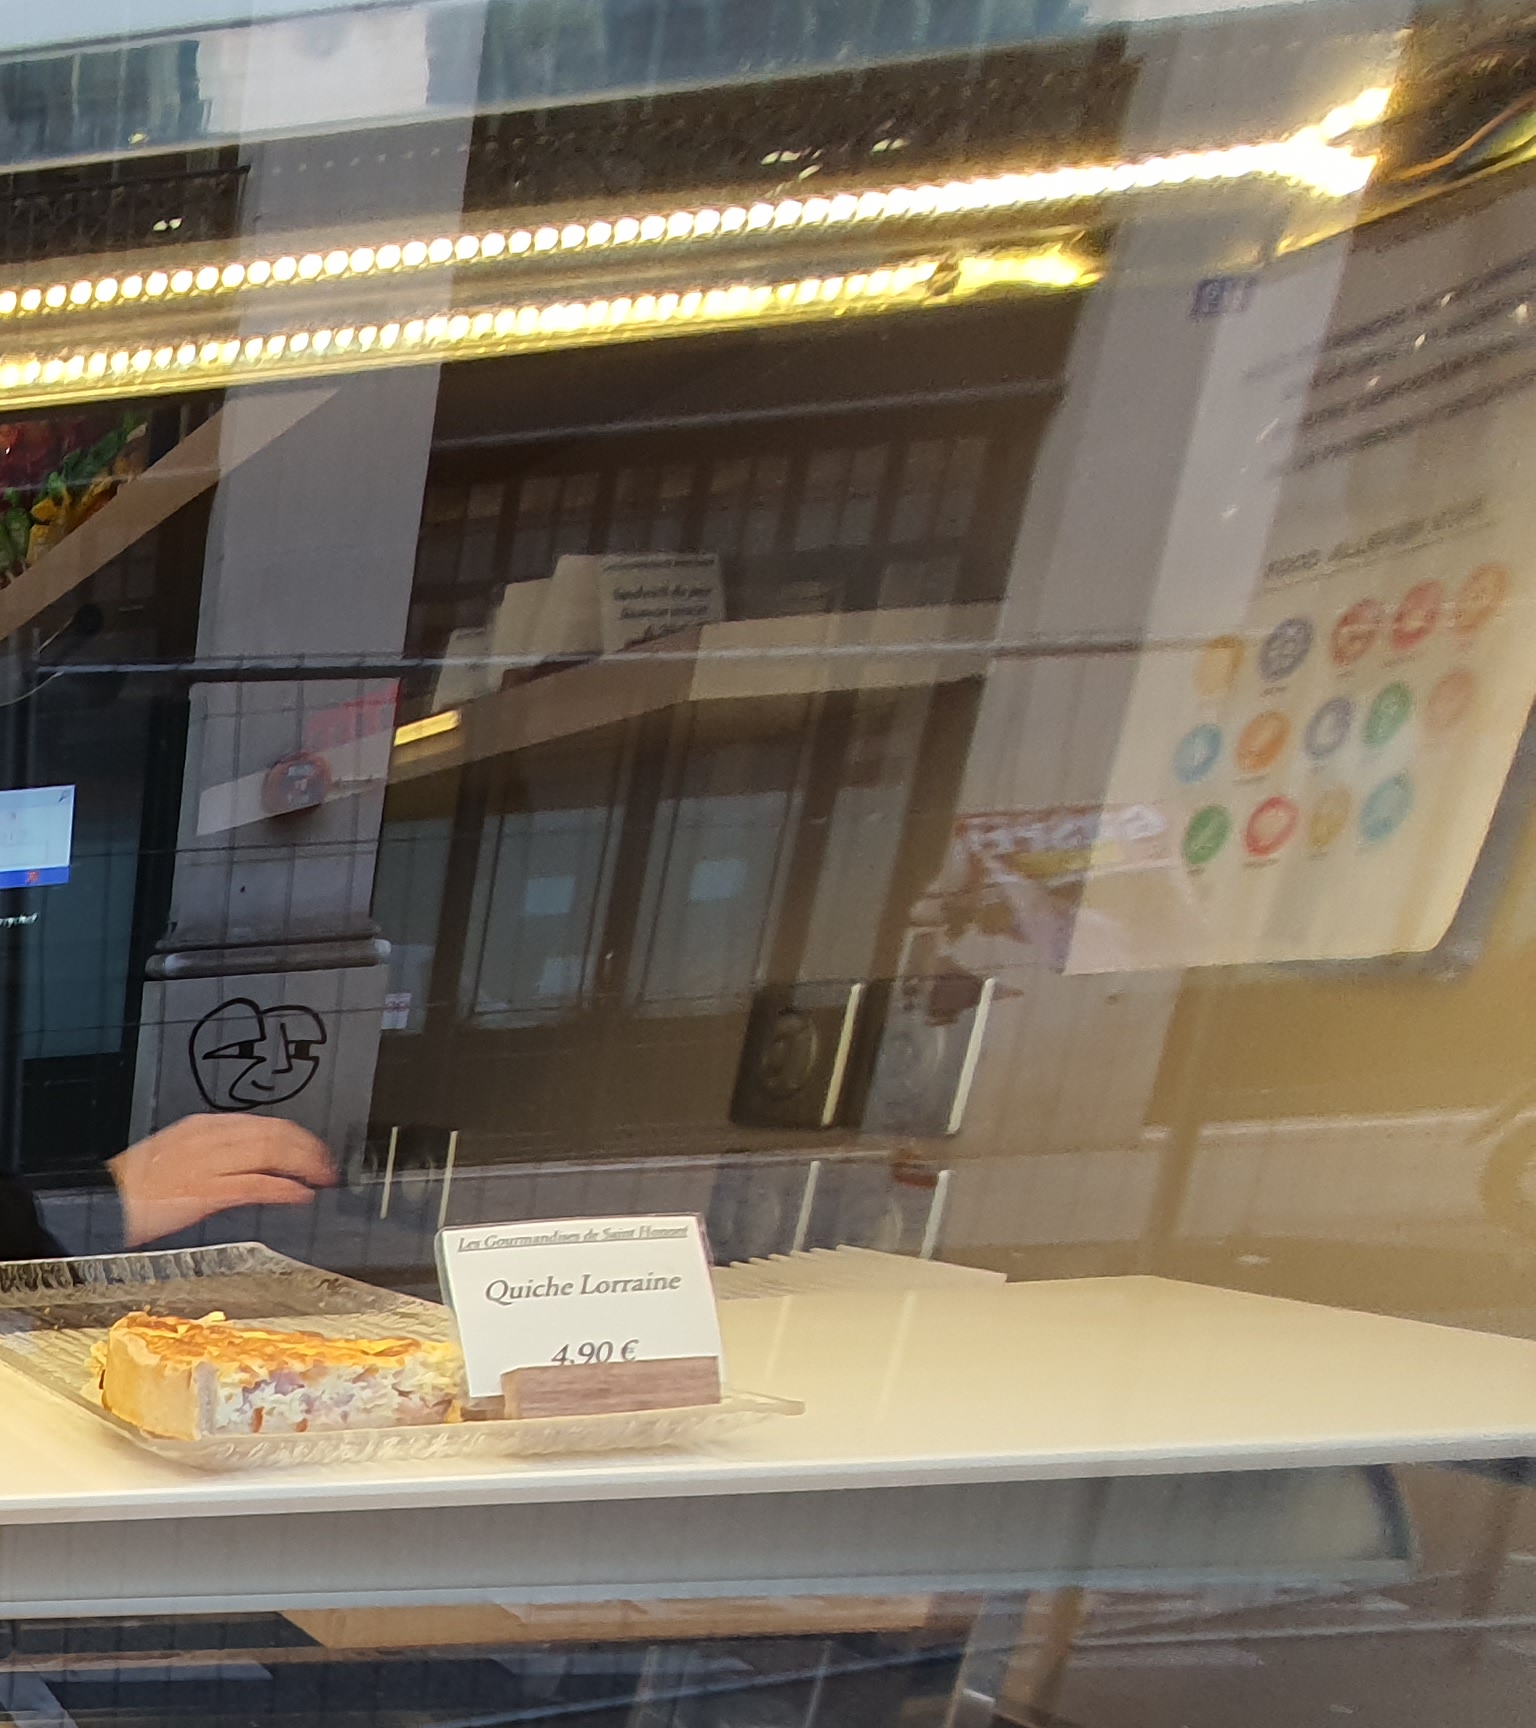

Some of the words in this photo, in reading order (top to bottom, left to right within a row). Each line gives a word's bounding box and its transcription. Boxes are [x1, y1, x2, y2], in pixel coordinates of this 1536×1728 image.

[458, 1237, 481, 1252] Les
[484, 1230, 580, 1250] Gourmandises
[584, 1228, 599, 1243] de
[485, 1275, 575, 1308] Quiche
[580, 1271, 682, 1295] Lorraine
[621, 1338, 639, 1362] €
